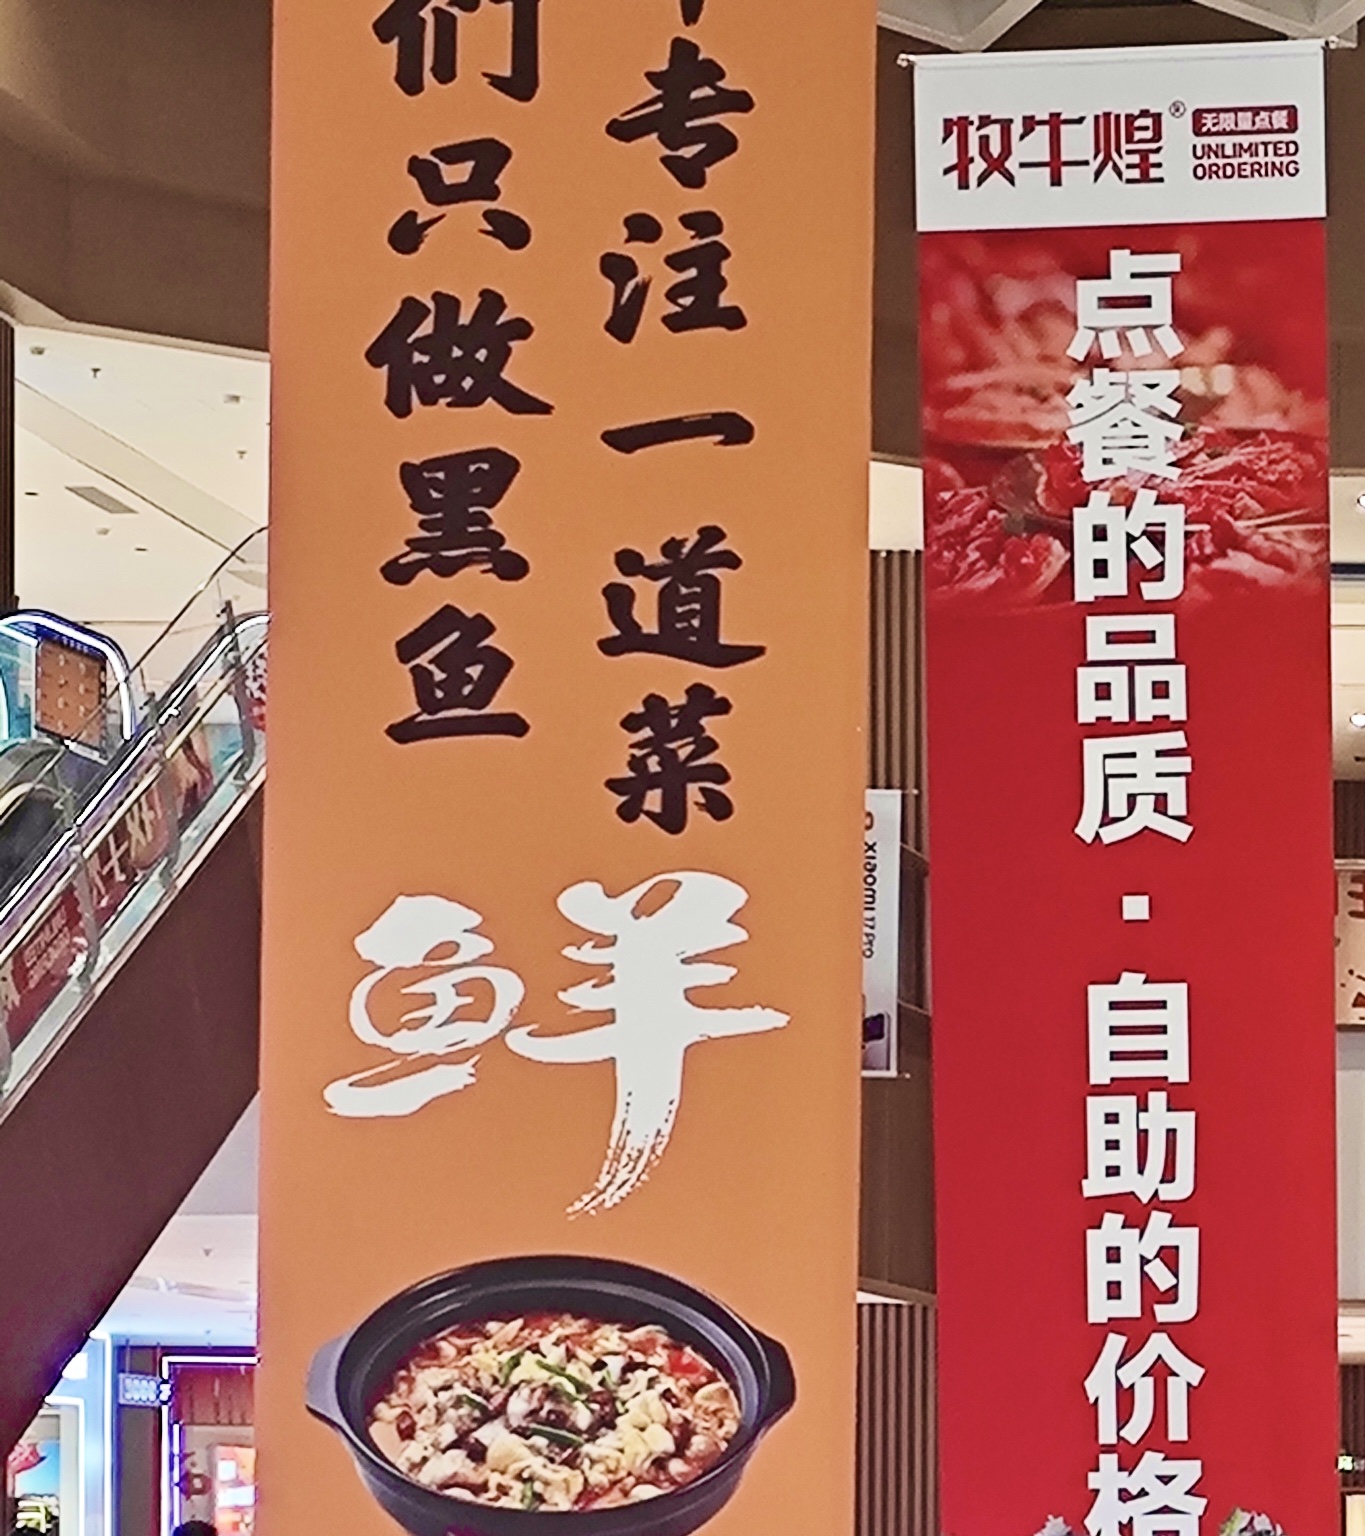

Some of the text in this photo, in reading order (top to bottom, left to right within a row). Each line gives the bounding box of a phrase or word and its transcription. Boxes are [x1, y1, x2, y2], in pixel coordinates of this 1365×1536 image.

[1192, 140, 1300, 160] UNLIMITED
[1192, 160, 1300, 181] ORDERING
[598, 0, 768, 834] 专注一道菜
